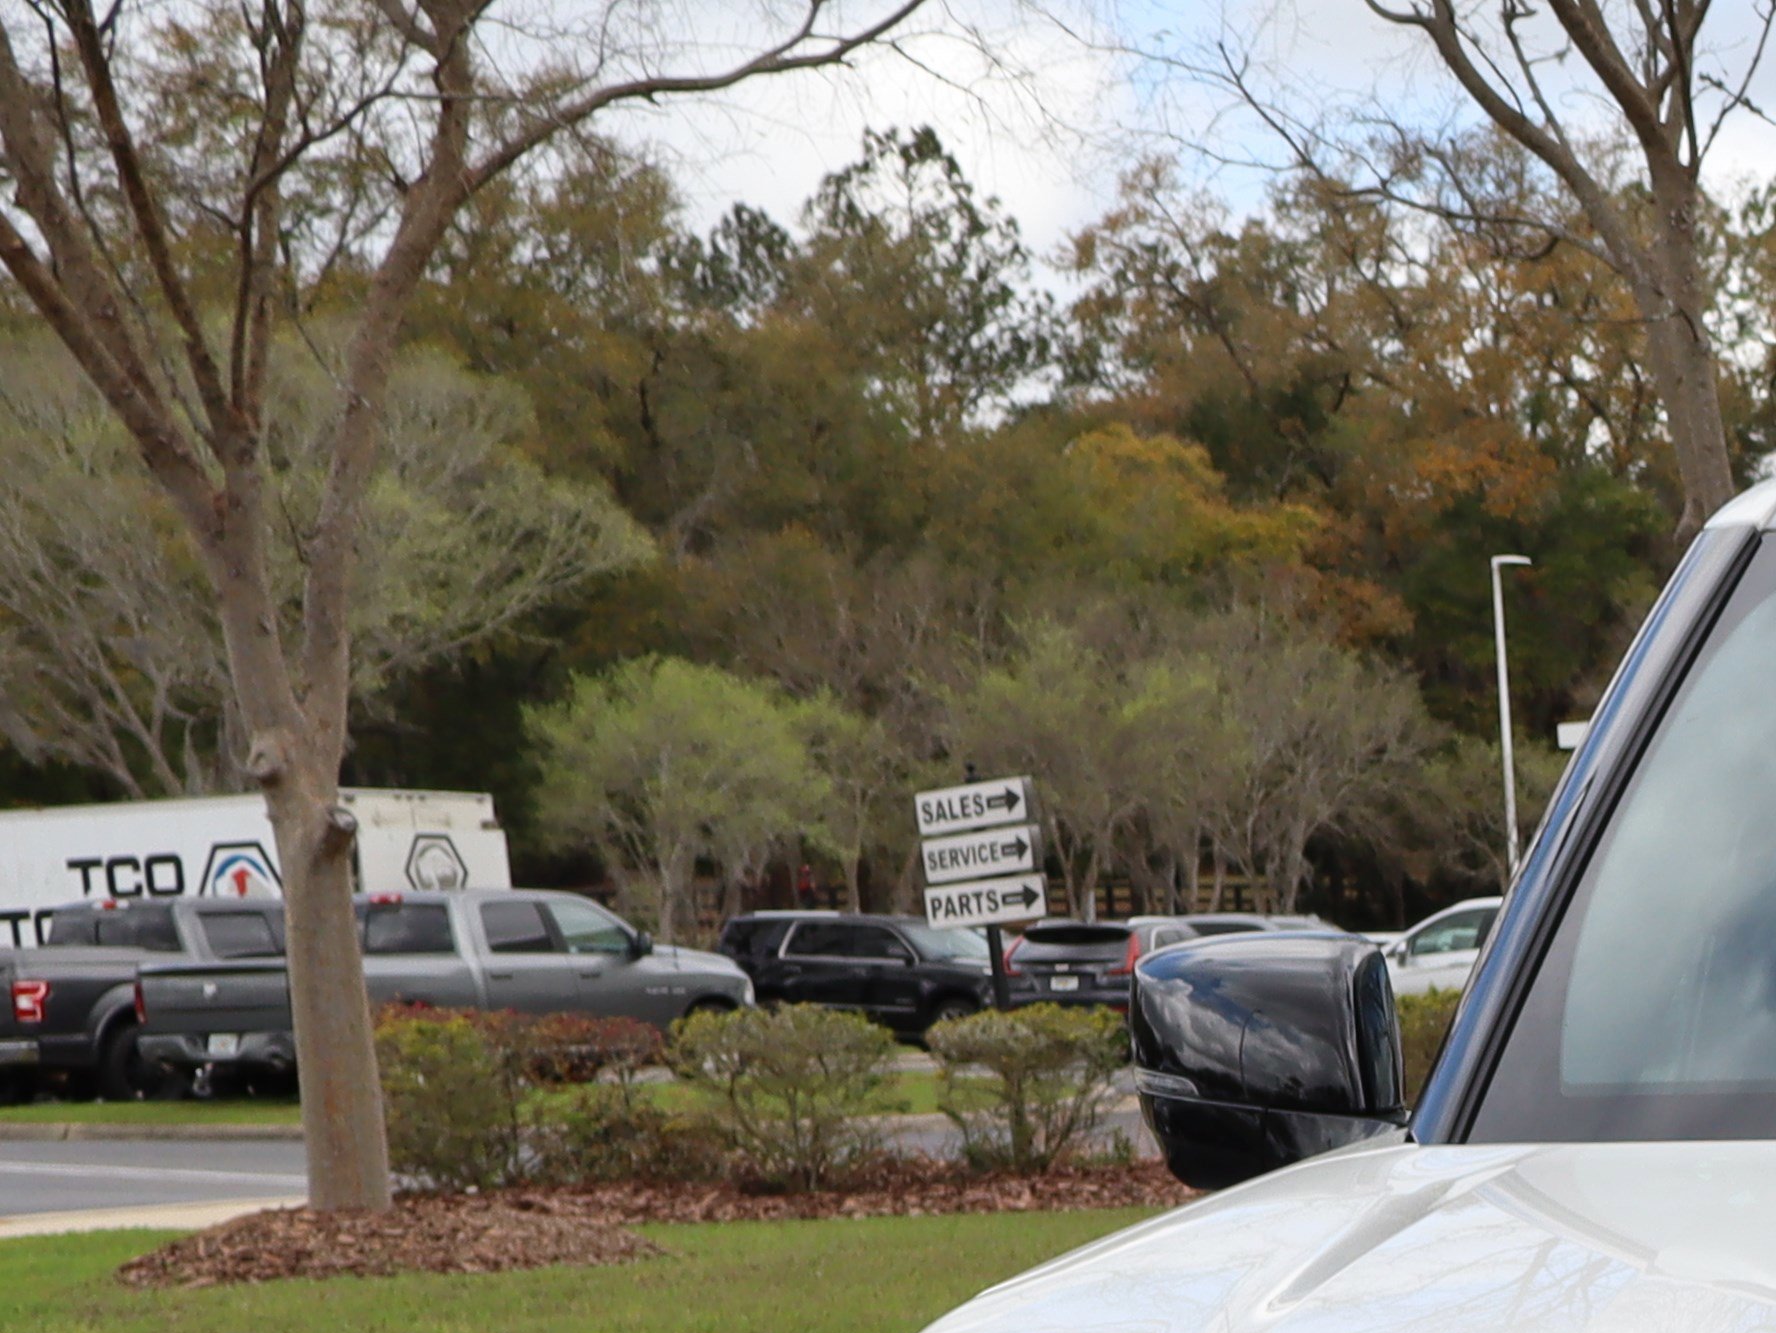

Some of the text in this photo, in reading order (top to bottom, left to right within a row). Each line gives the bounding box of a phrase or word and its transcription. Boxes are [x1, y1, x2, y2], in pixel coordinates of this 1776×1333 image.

[922, 793, 985, 824] SALES
[927, 841, 999, 871] SERVICE
[66, 853, 185, 898] TCO
[930, 889, 999, 919] PARTS
